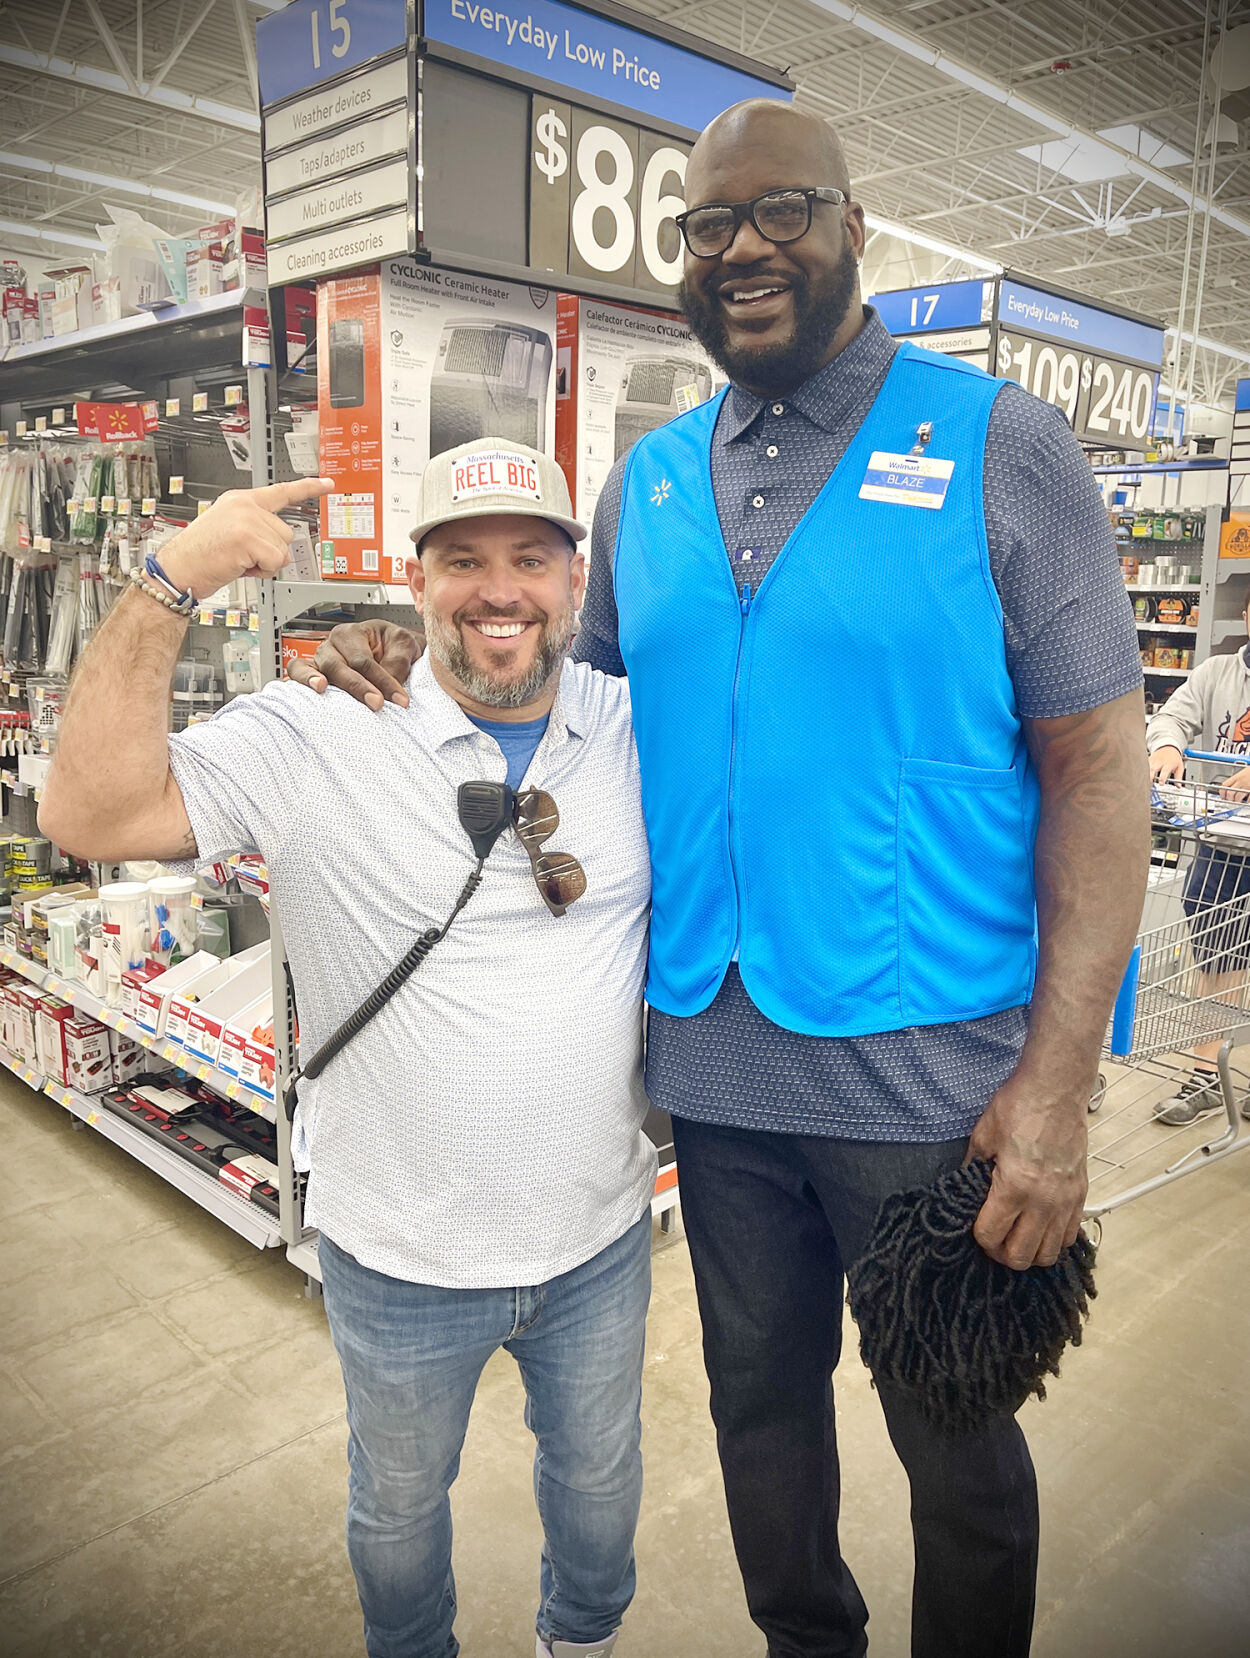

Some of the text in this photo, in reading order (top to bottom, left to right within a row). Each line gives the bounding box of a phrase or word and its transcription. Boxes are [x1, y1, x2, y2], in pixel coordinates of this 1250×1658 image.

[311, 0, 351, 69] 15
[451, 0, 661, 90] Everyday Low Price
[293, 88, 371, 130] Weather devices
[300, 141, 365, 176] Taps/adapters
[303, 190, 363, 221] Multi outlets
[287, 233, 384, 272] Cleaning accessories
[390, 263, 441, 285] CYCLONIC
[444, 277, 479, 295] Ceramic
[481, 285, 509, 300] Heater
[390, 278, 496, 308] Full Room Heater with Front Air Intake
[586, 309, 693, 341] Calefactor Cerámico CYCLONIC
[910, 294, 940, 327] 17
[1008, 295, 1080, 330] Everyday Low Price
[927, 338, 972, 350] accessories
[1081, 357, 1153, 439] $240
[105, 431, 138, 440] Rollback
[467, 451, 524, 464] Massachusetts
[889, 461, 920, 472] Walmart
[455, 461, 537, 492] REEL BIG
[887, 474, 926, 488] BLAZE
[395, 557, 404, 572] 3
